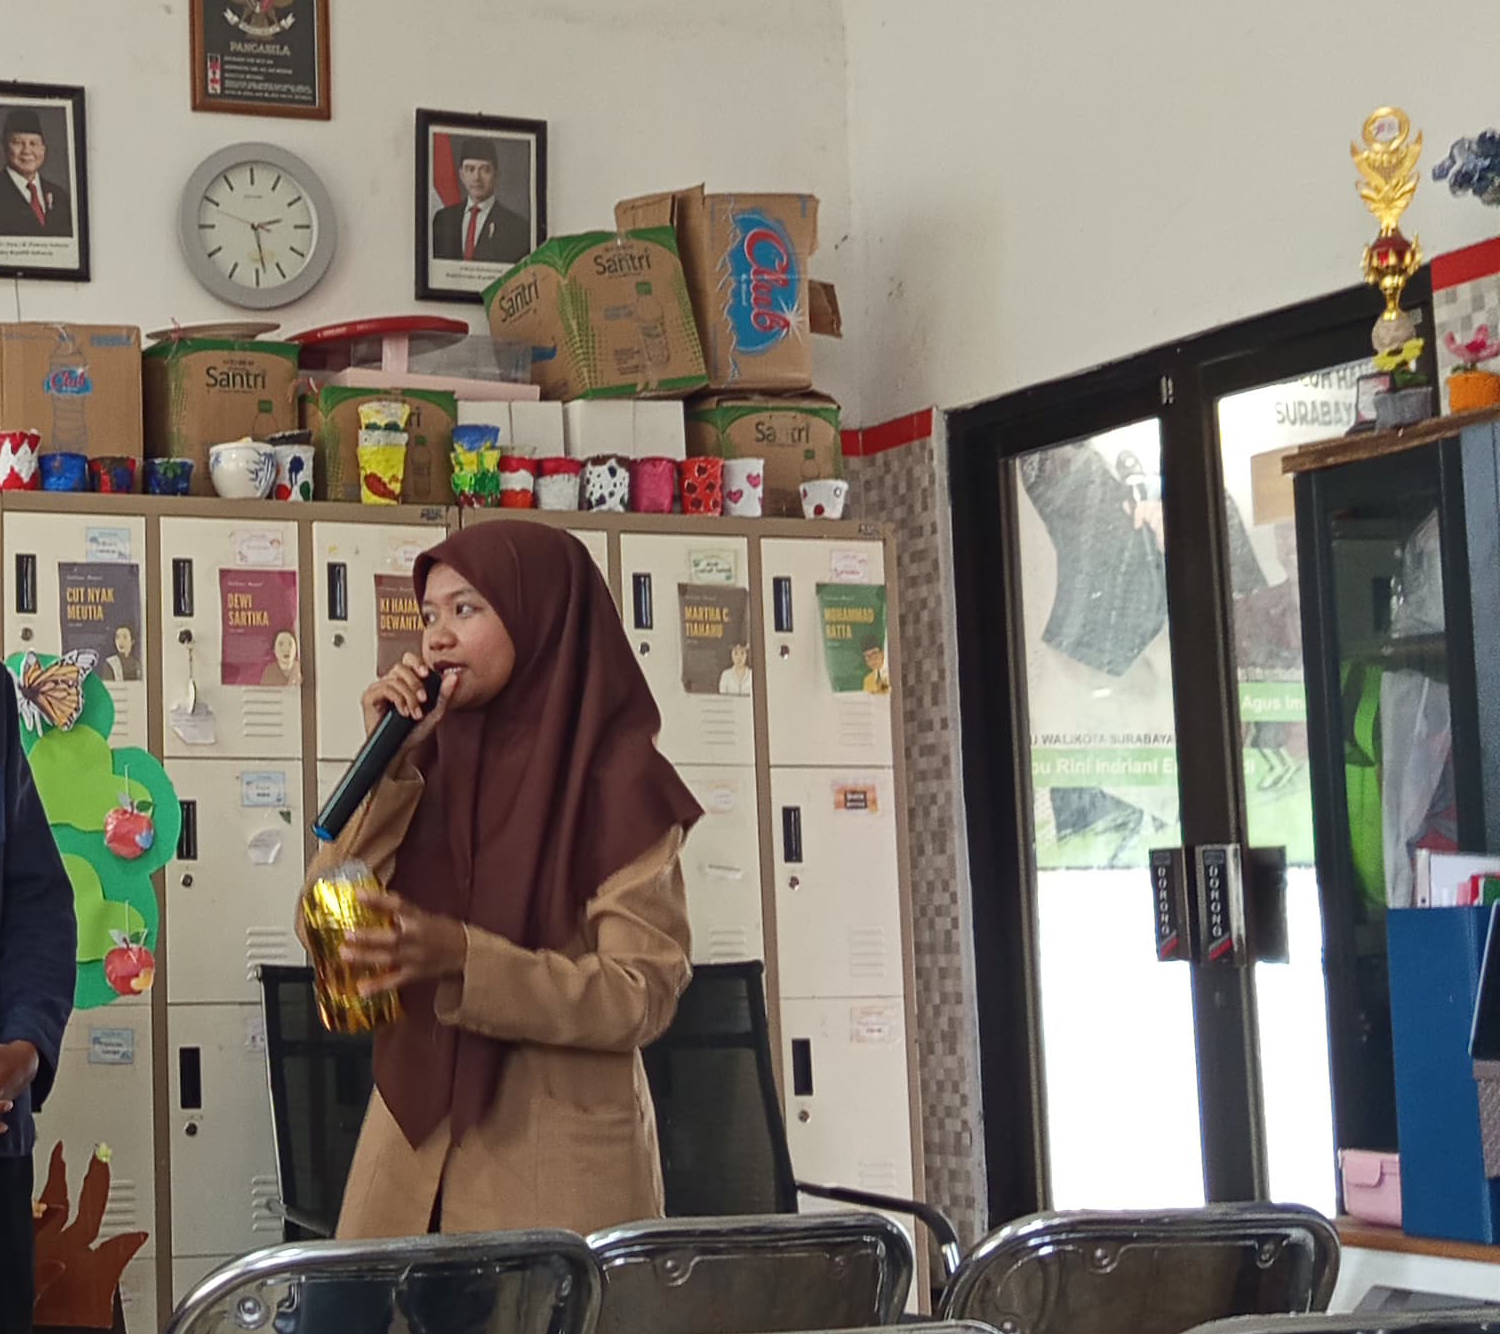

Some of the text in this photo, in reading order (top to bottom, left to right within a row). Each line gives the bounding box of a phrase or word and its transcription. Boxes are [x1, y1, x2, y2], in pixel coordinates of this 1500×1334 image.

[230, 42, 291, 56] PANCASILA
[594, 247, 652, 276] Santri
[744, 229, 790, 331] Club
[500, 273, 540, 322] Santri
[51, 370, 85, 389] Club
[206, 366, 266, 388] Santri
[755, 421, 811, 444] Satri
[66, 587, 114, 603] CUT NYAK
[227, 593, 252, 609] DEWI
[67, 604, 104, 621] MEUTIA
[228, 610, 269, 627] SARTIKA
[685, 606, 721, 622] MARTHA
[1241, 694, 1281, 713] Agus
[1041, 733, 1105, 745] WALIKOTA
[1109, 733, 1174, 745] SURABAYA
[1208, 866, 1222, 937] DORONG
